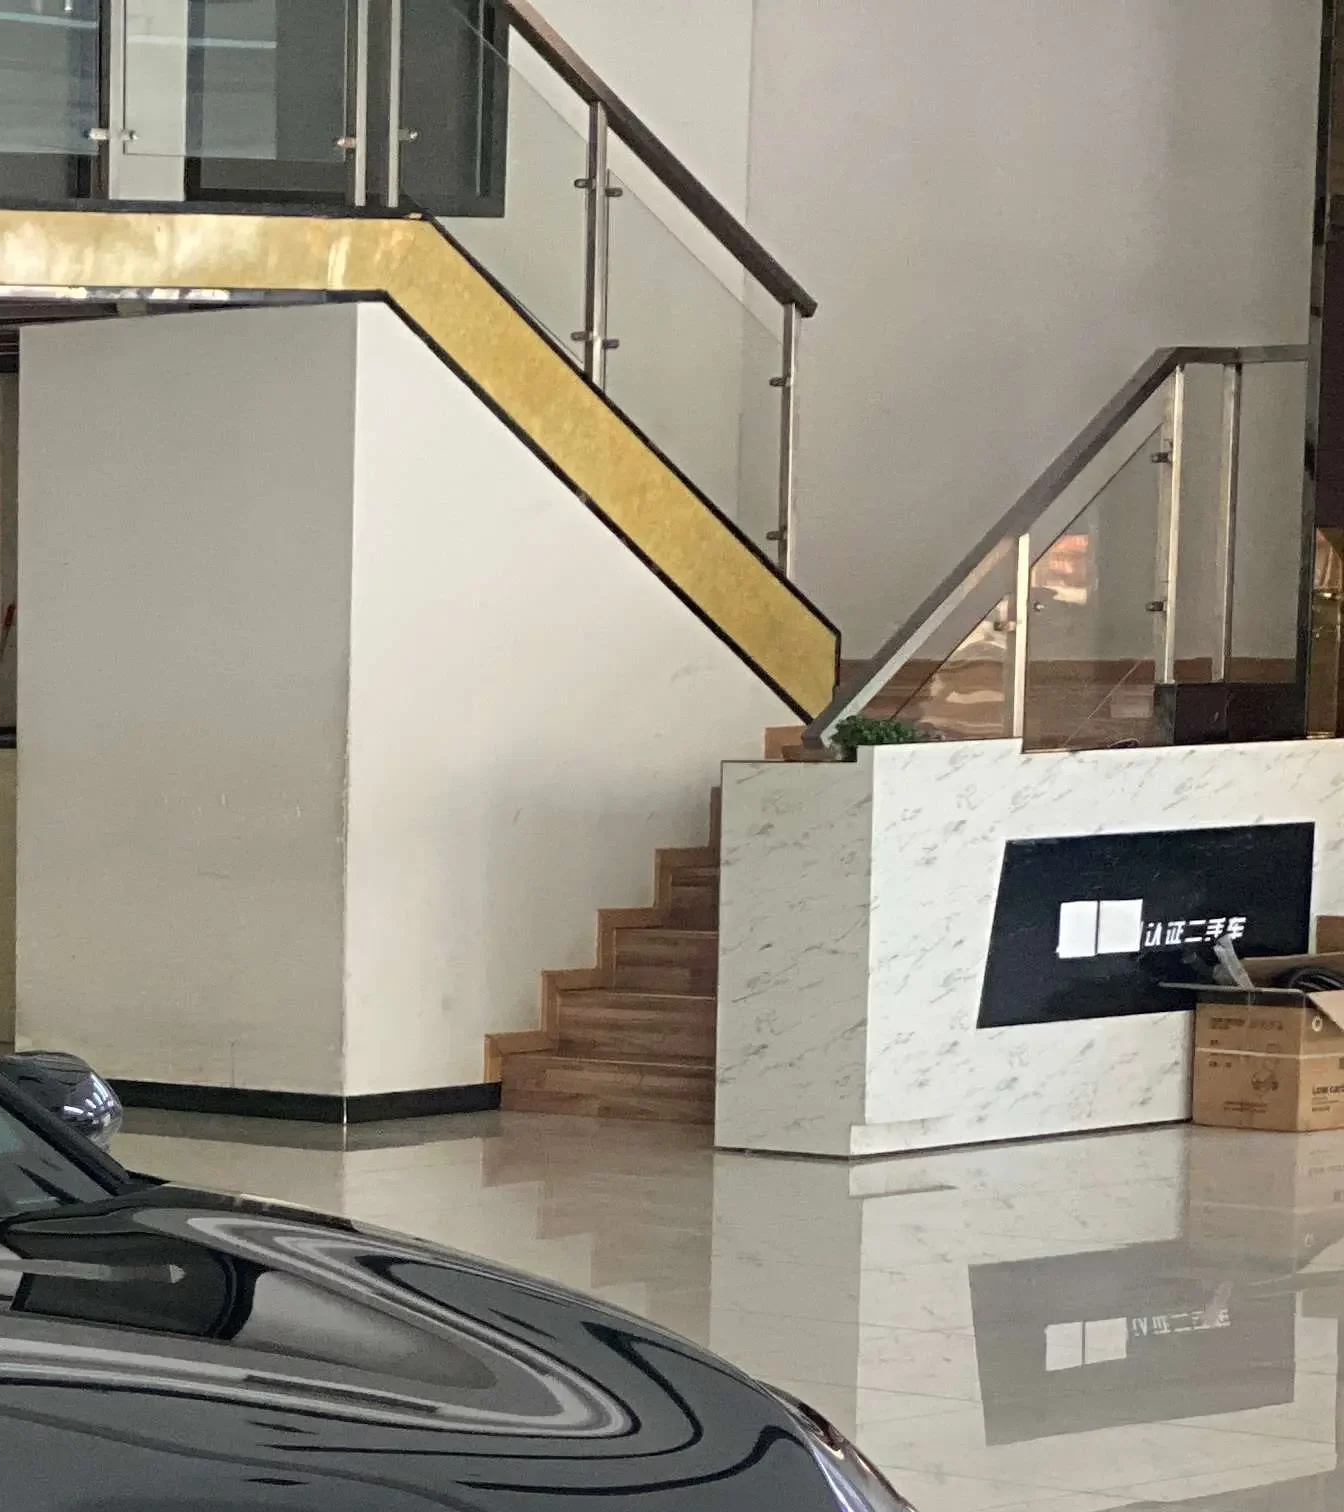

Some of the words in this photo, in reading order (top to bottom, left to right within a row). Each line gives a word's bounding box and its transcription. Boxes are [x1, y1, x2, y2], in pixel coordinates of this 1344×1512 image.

[1144, 917, 1247, 947] 认证二手车
